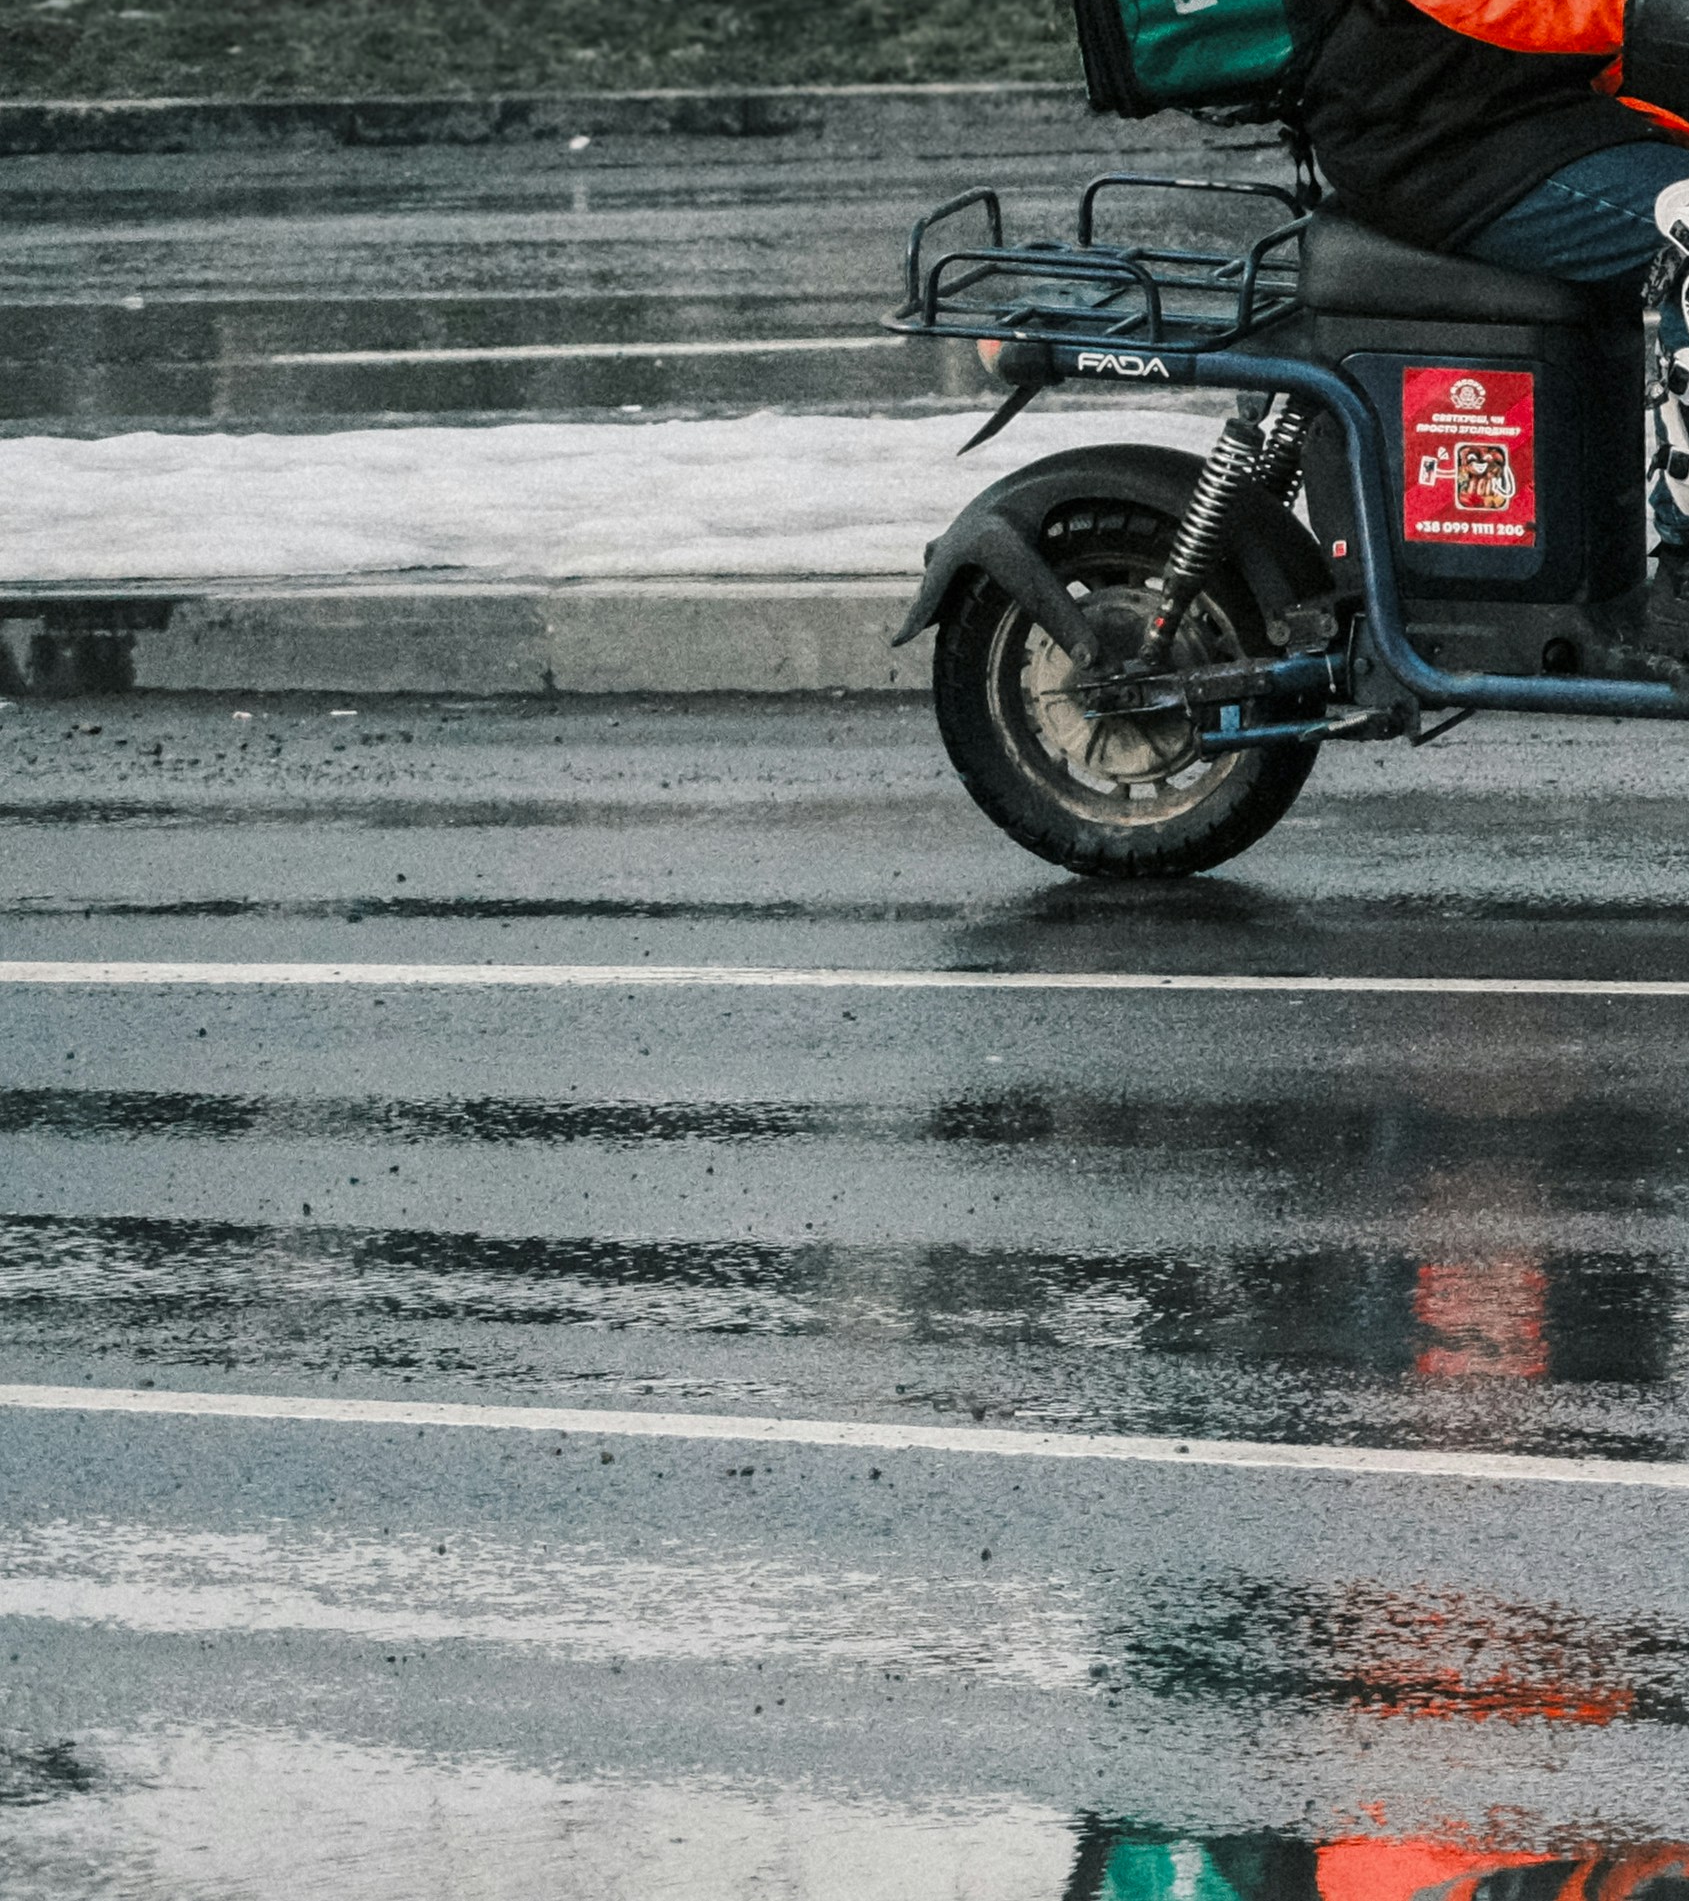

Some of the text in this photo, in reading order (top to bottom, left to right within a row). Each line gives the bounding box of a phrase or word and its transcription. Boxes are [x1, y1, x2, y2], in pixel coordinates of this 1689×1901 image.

[1078, 352, 1170, 378] FADA
[1416, 423, 1458, 433] ПРОСТО
[1415, 520, 1441, 533] +38
[1442, 521, 1469, 534] 099
[1471, 522, 1494, 535] 1111
